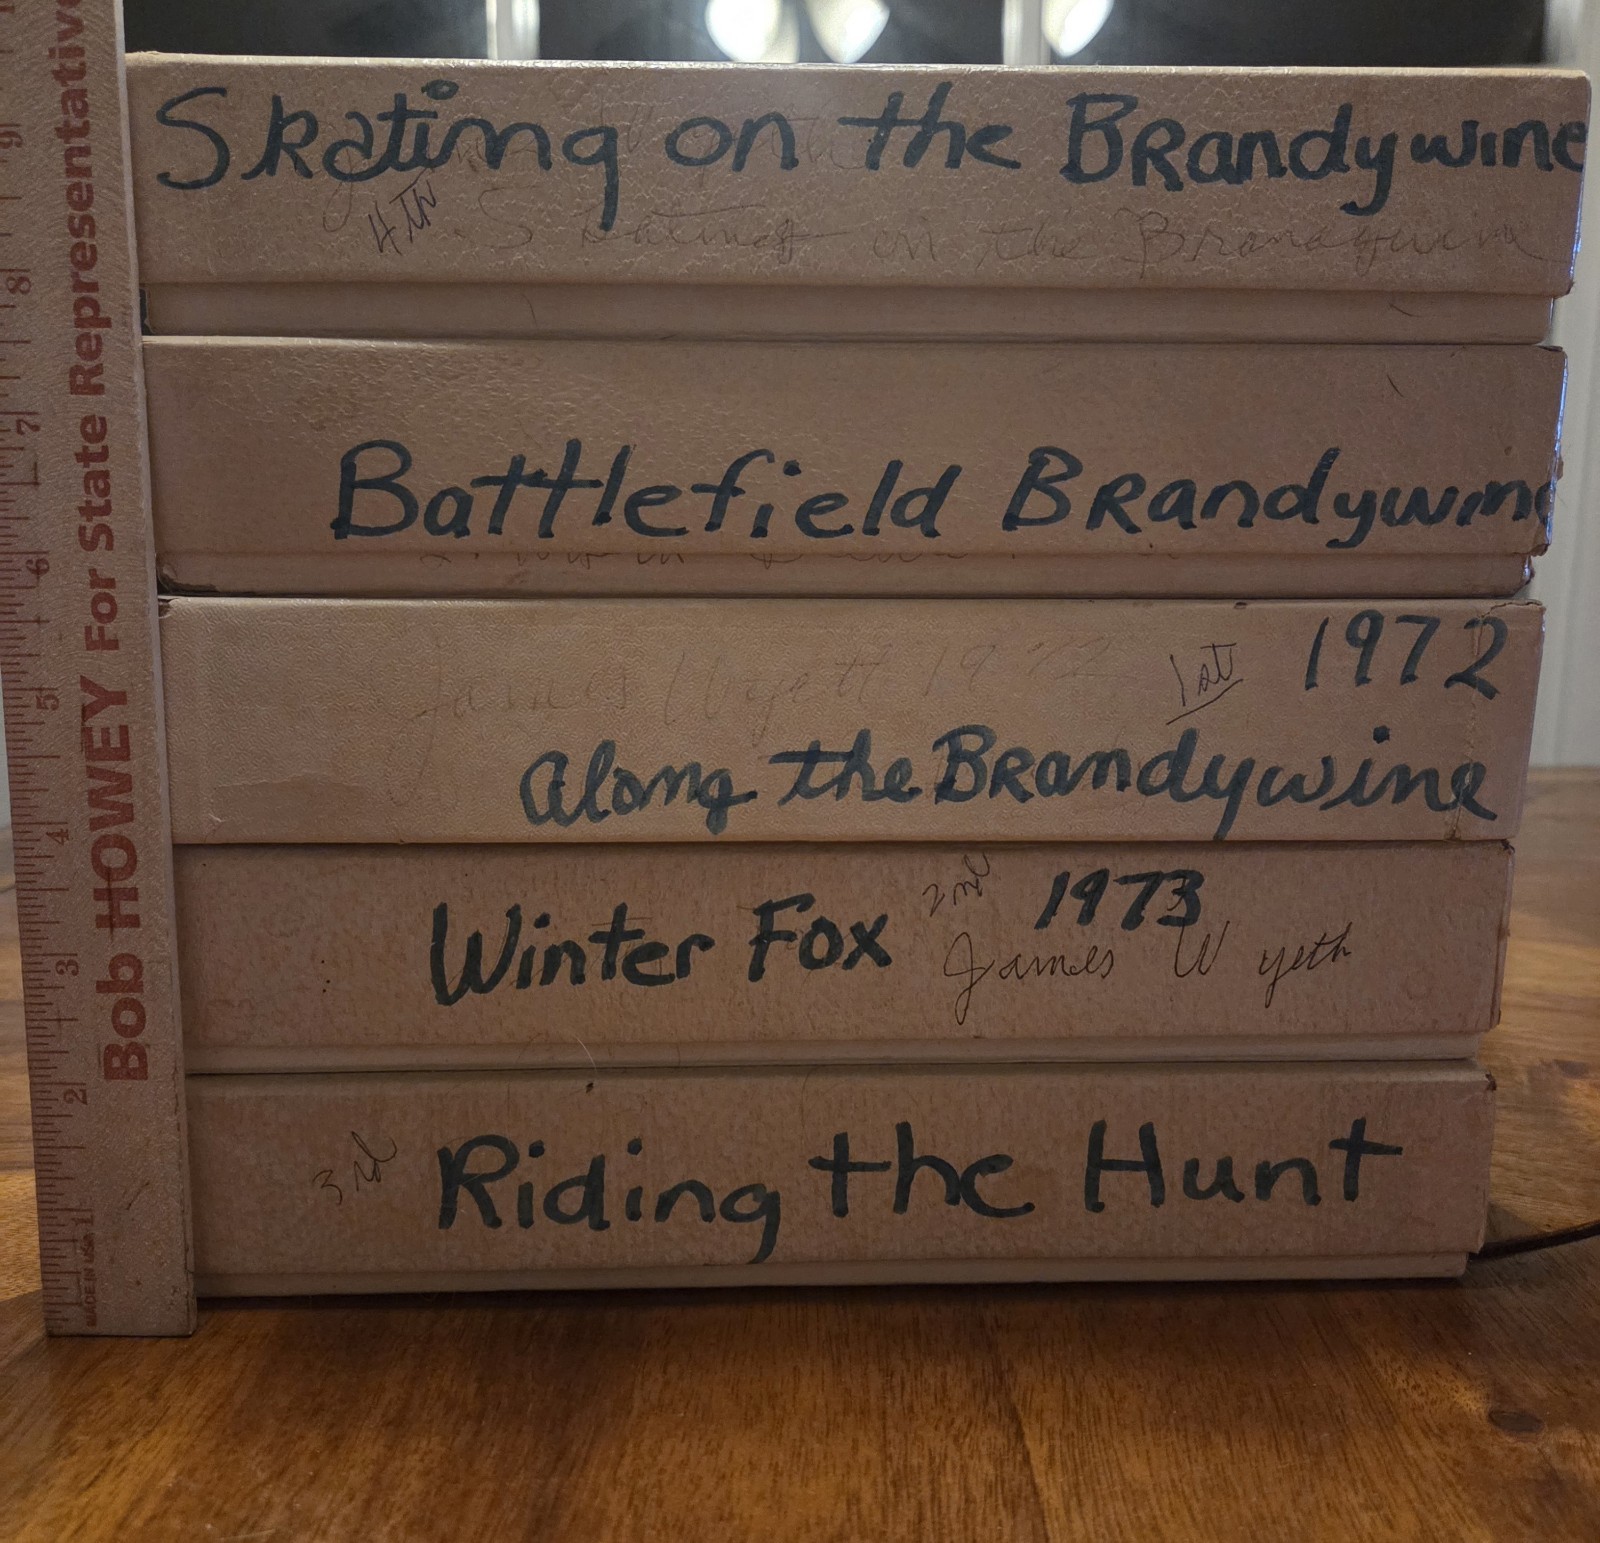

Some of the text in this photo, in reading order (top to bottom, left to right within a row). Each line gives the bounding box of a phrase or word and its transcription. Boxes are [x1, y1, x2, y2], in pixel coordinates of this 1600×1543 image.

[156, 79, 620, 231] Skating
[664, 110, 799, 172] on
[838, 80, 1021, 171] the
[6, 274, 32, 295] 8
[16, 418, 41, 437] 7
[330, 438, 964, 540] Battlefield
[26, 558, 50, 577] 6
[48, 0, 149, 1081] Bob HOWEY For State Representativ
[1305, 609, 1509, 700] 1972
[36, 692, 60, 711] 5
[768, 728, 923, 807] the
[46, 828, 70, 845] 4
[1033, 868, 1205, 932] 1973
[55, 953, 79, 977] 3
[430, 902, 715, 1006] Winter
[943, 931, 1115, 1026] James
[63, 1082, 88, 1105] 2
[436, 1117, 1404, 1265] Riding the Hunt
